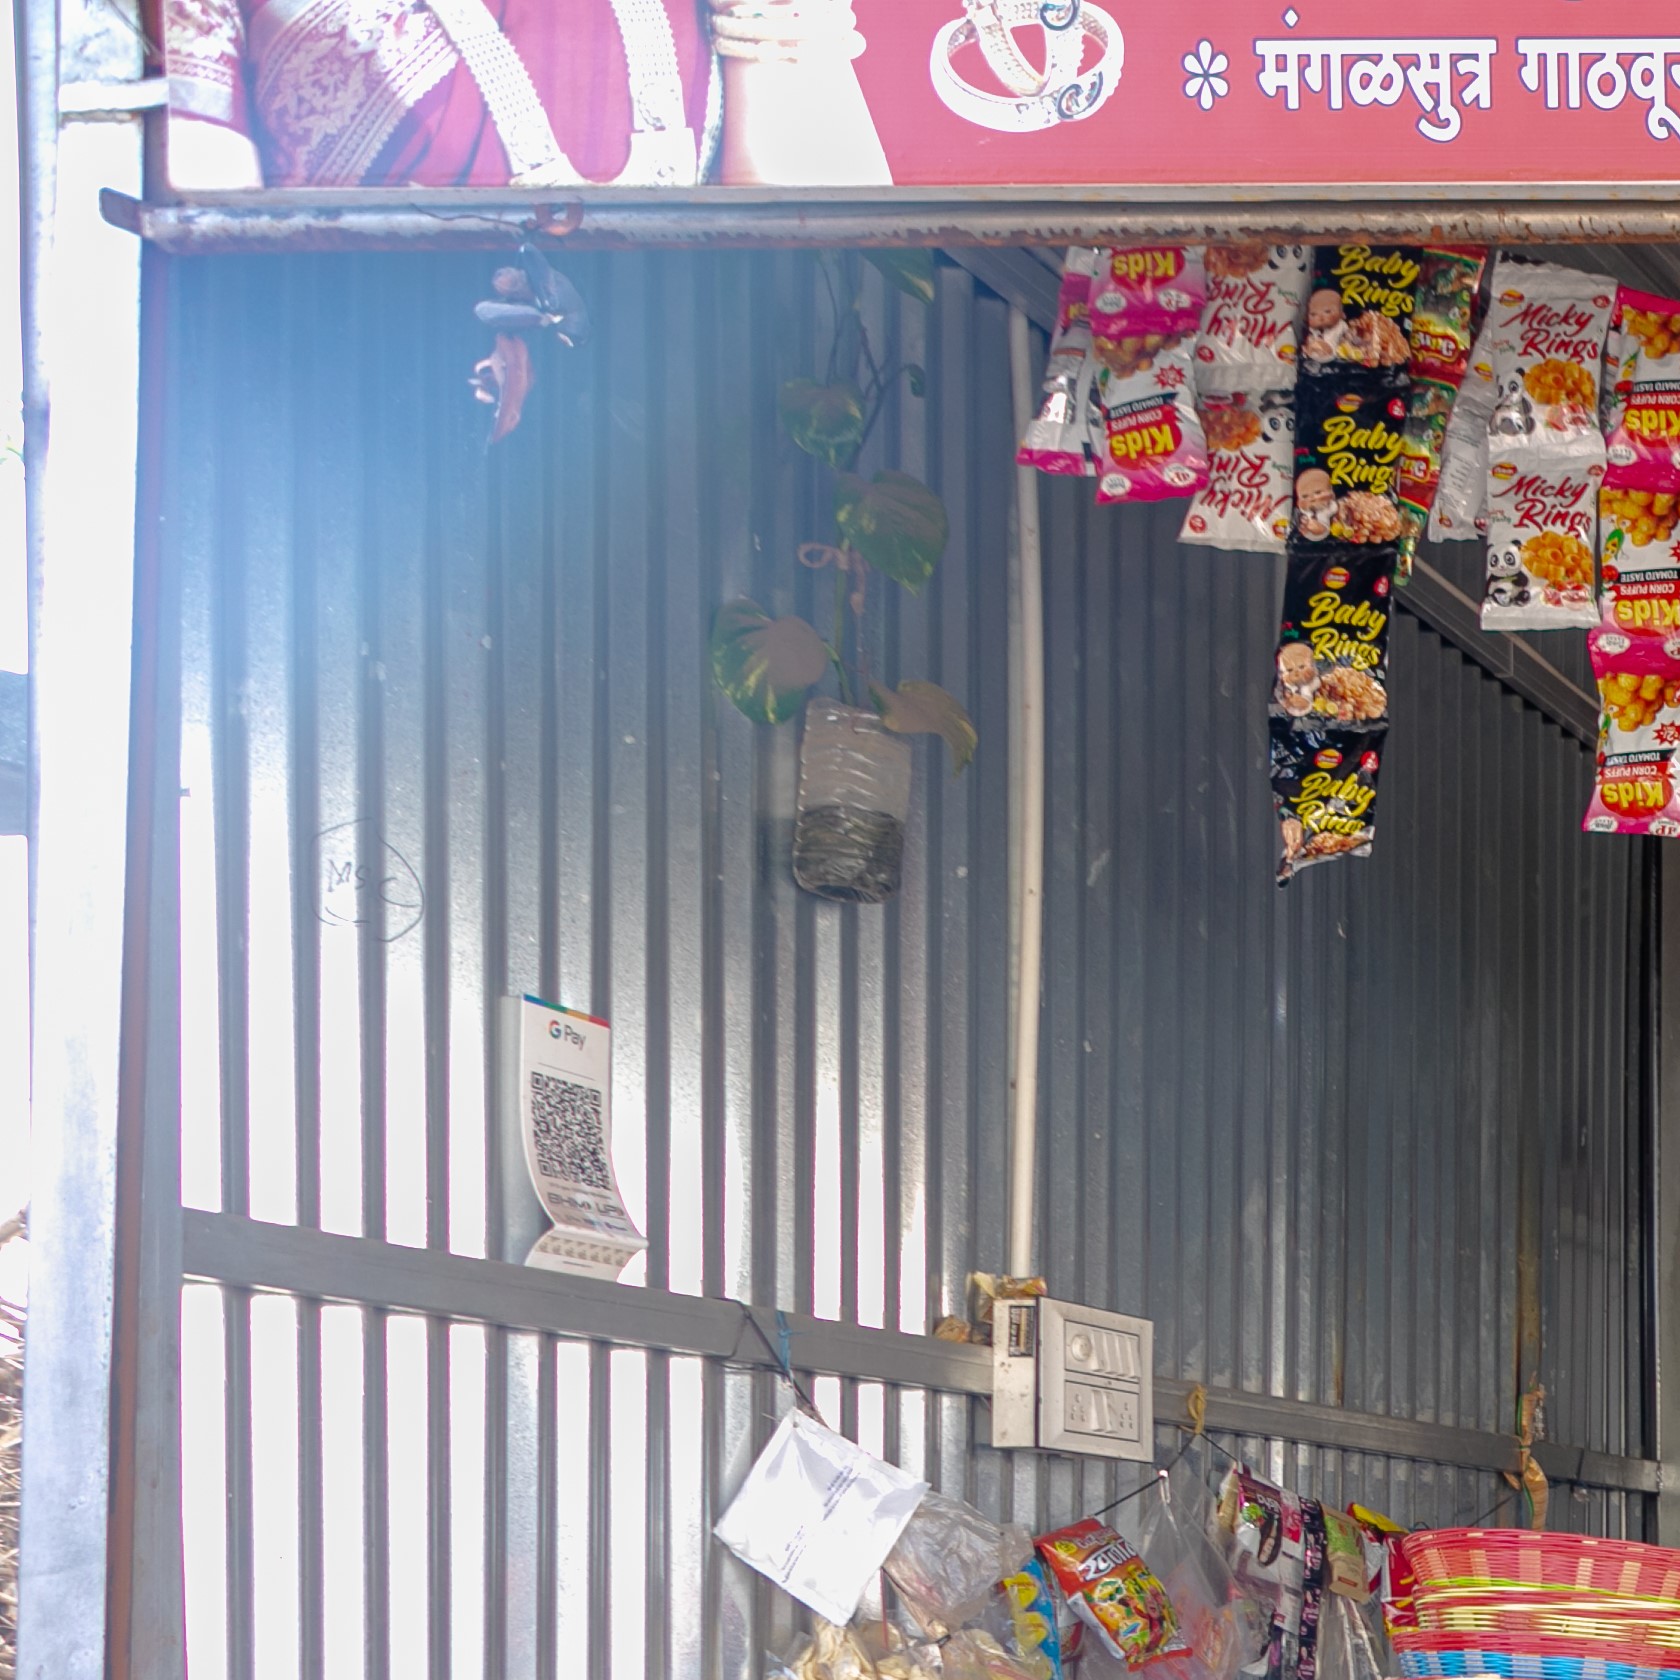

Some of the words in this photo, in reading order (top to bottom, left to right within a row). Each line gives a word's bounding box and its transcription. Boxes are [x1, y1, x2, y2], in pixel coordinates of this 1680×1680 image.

[1253, 8, 1499, 143] मंगळसुत्र
[1113, 250, 1175, 279] Kids
[1338, 244, 1421, 287] Baby
[1341, 277, 1416, 318] Rings
[1207, 303, 1292, 349] Micky
[1500, 302, 1594, 337] Micky
[1110, 424, 1175, 459] Kids
[1324, 416, 1405, 460] Baby
[1620, 571, 1643, 582] TASTE
[1645, 569, 1678, 581] TOMATO
[1302, 591, 1387, 641] Baby
[1311, 628, 1381, 670] Rings
[563, 1024, 586, 1051] Pay
